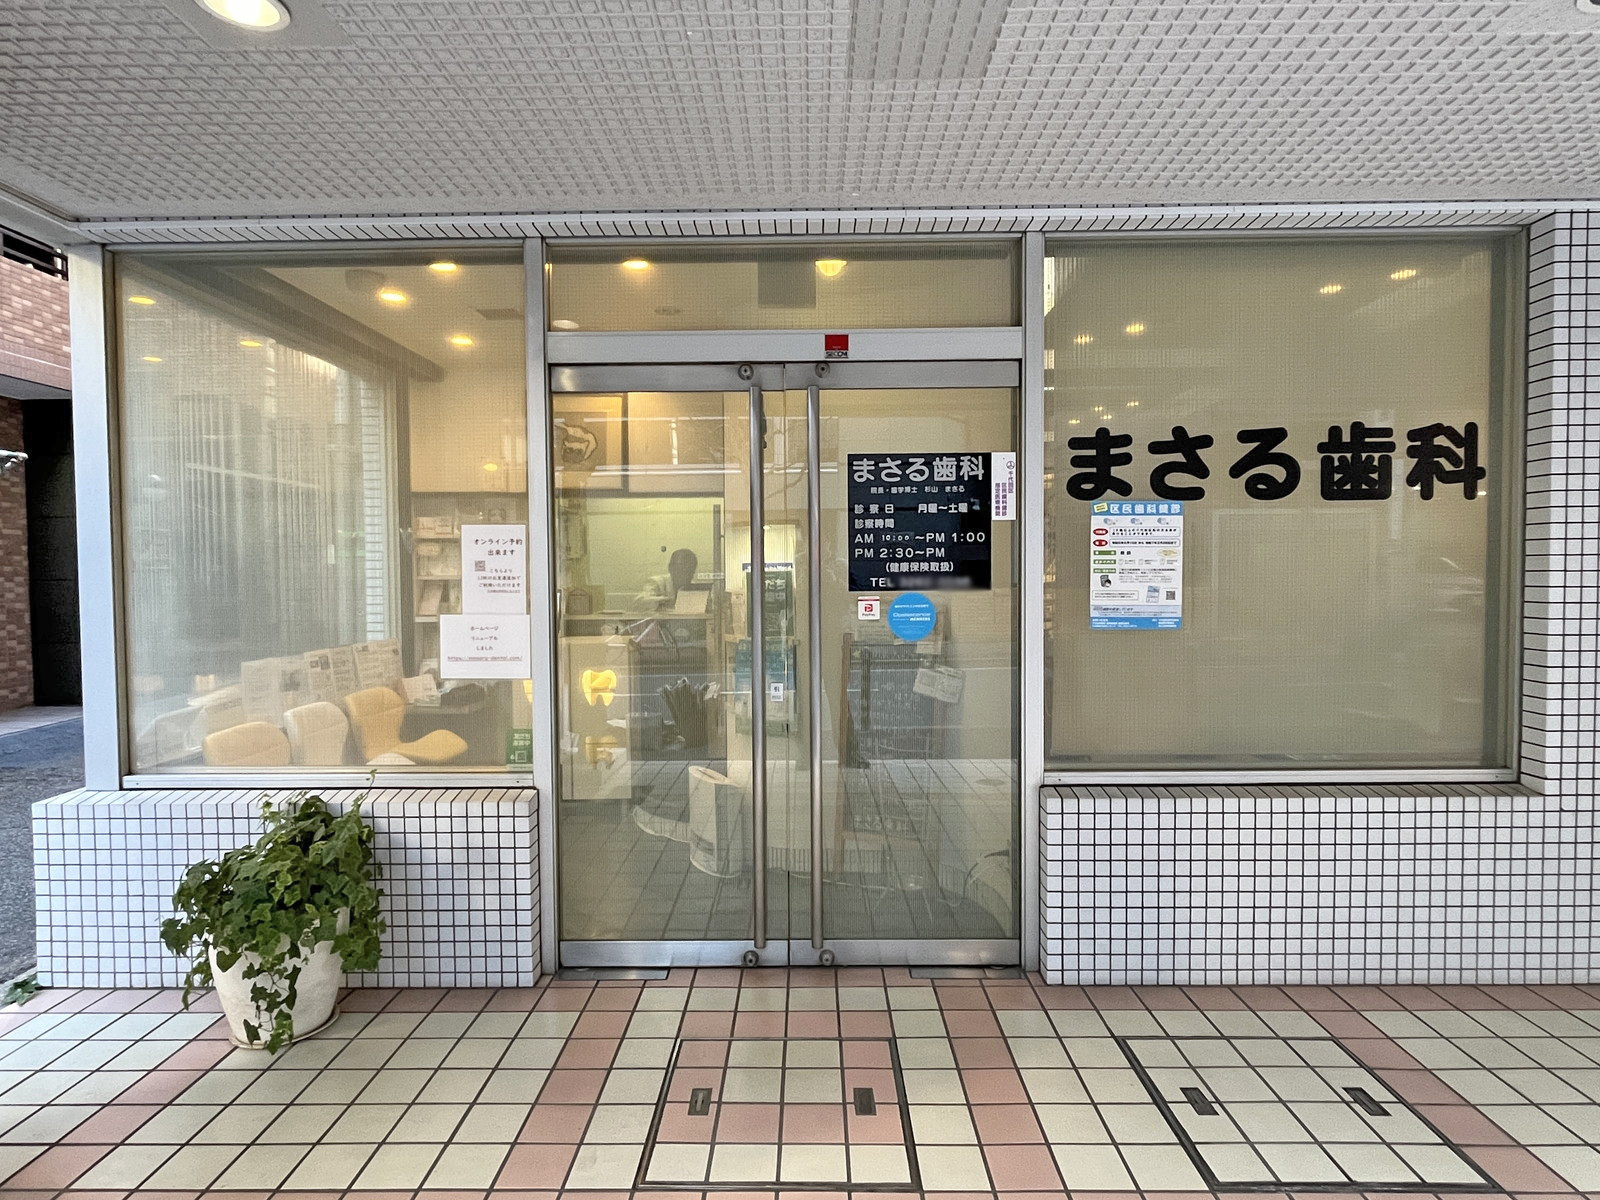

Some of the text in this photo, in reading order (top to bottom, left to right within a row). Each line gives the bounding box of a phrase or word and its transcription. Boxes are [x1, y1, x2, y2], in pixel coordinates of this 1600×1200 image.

[1066, 421, 1487, 502] まさる歯科
[852, 455, 985, 483] まさる歯科
[924, 485, 939, 493] 杉山
[944, 485, 965, 493] まさる
[854, 504, 895, 514] 診察日
[854, 518, 895, 529] 診察時間
[474, 538, 523, 546] オンライン予約
[854, 533, 874, 544] AM
[881, 534, 910, 542] 10:00
[951, 531, 987, 542] 1:00
[854, 549, 874, 559] PM
[869, 577, 893, 588] TEL
